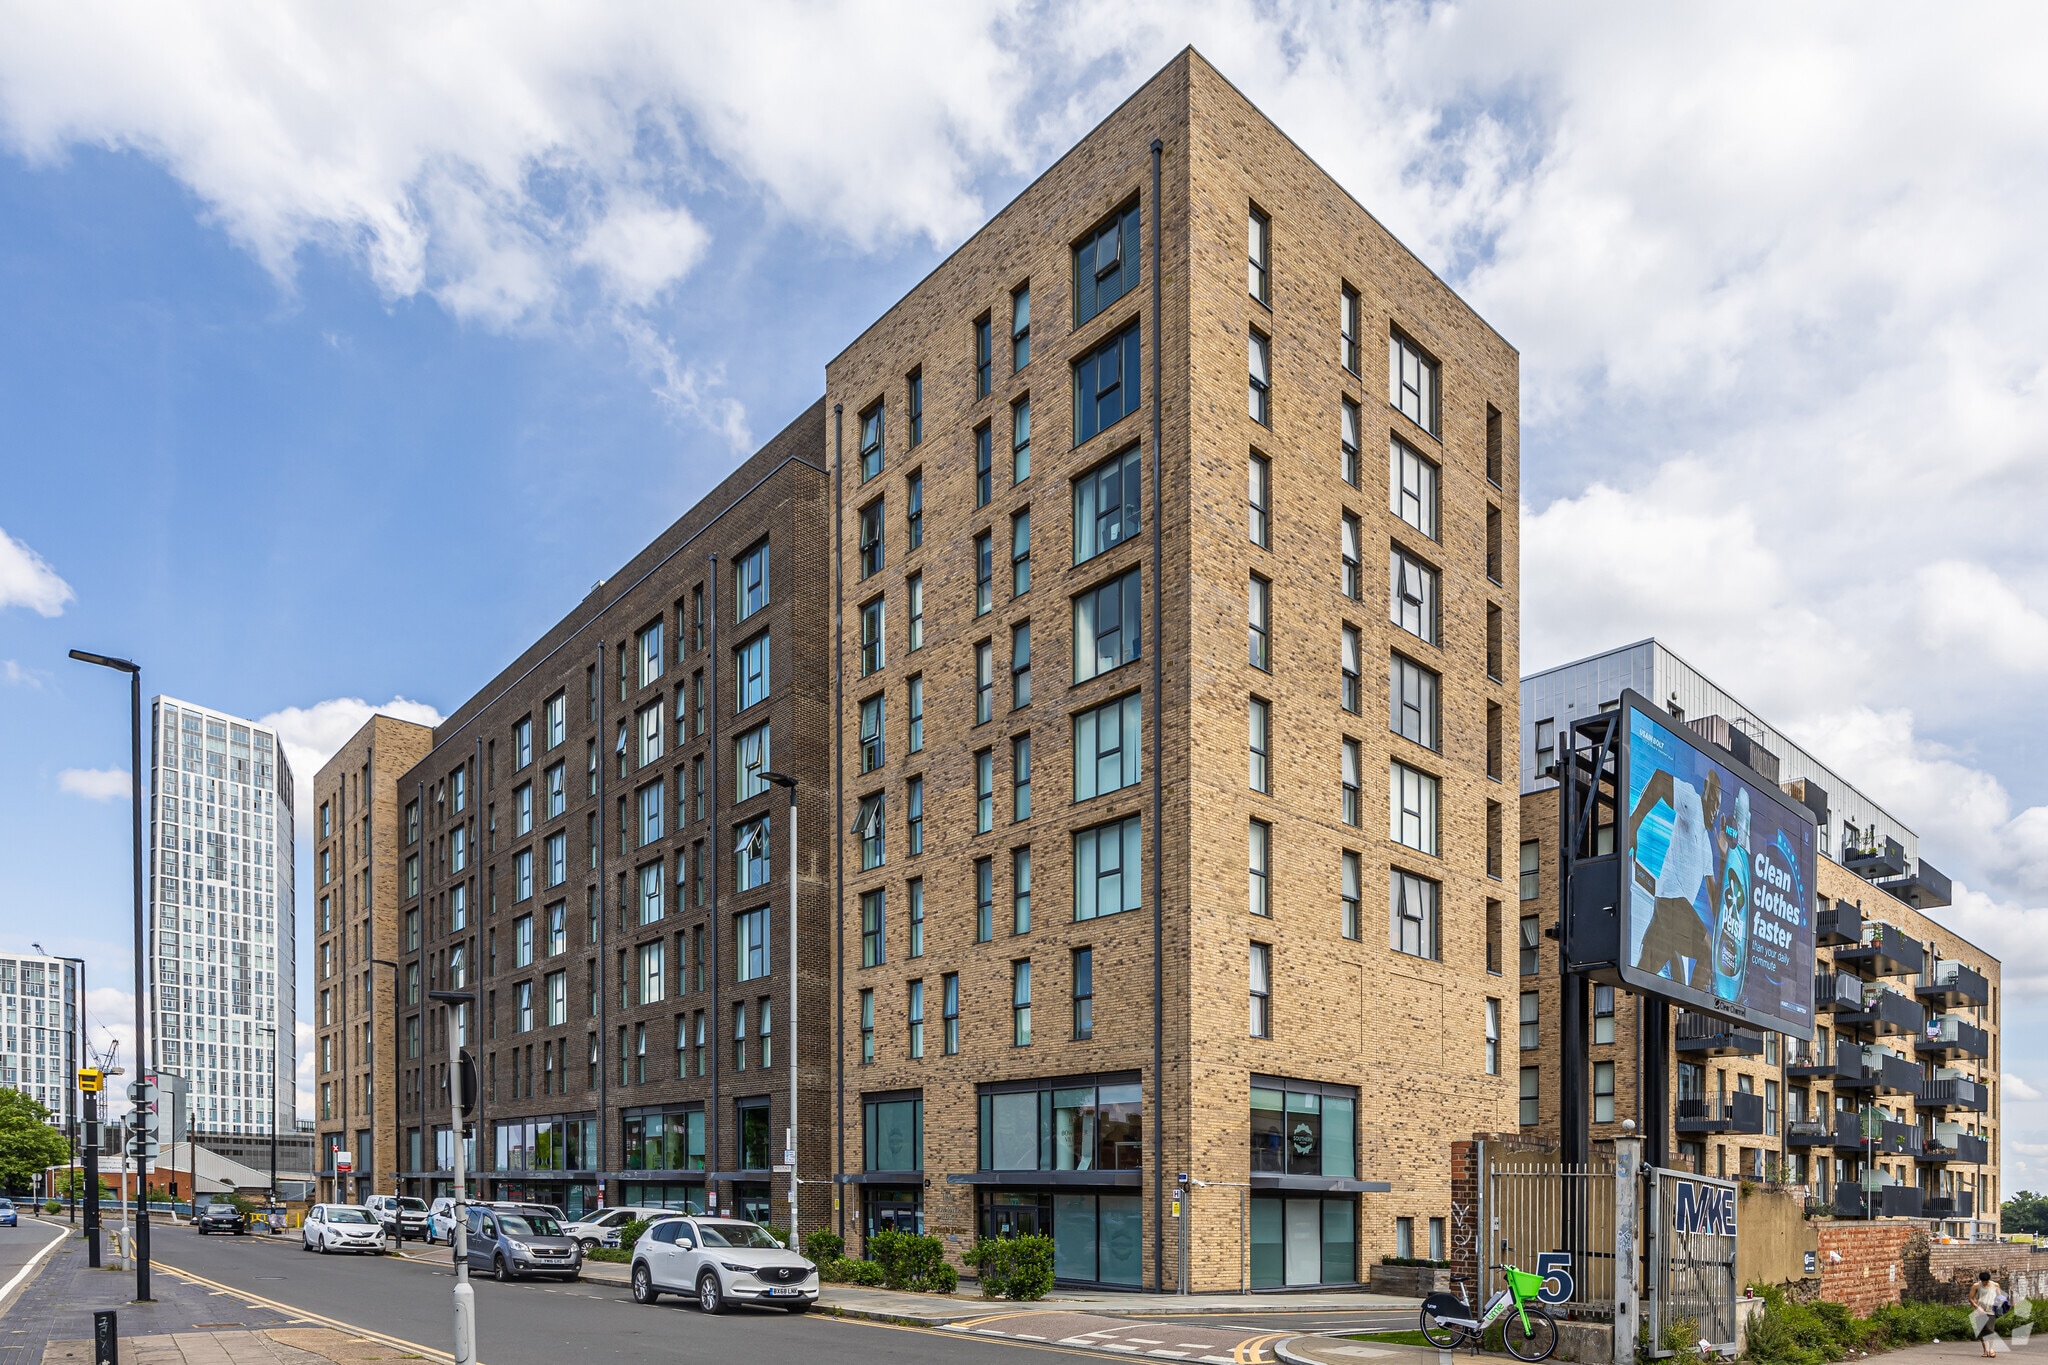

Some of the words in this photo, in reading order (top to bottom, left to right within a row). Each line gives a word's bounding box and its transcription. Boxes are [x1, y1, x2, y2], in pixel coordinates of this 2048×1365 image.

[1725, 825, 1738, 838] NEW
[1754, 853, 1791, 892] Clean
[1753, 884, 1800, 926] clothes
[1753, 911, 1792, 949] faster
[1751, 939, 1764, 954] than
[1764, 946, 1777, 960] your
[1777, 949, 1790, 966] daily
[1751, 954, 1777, 972] commute
[1535, 1252, 1574, 1305] 5
